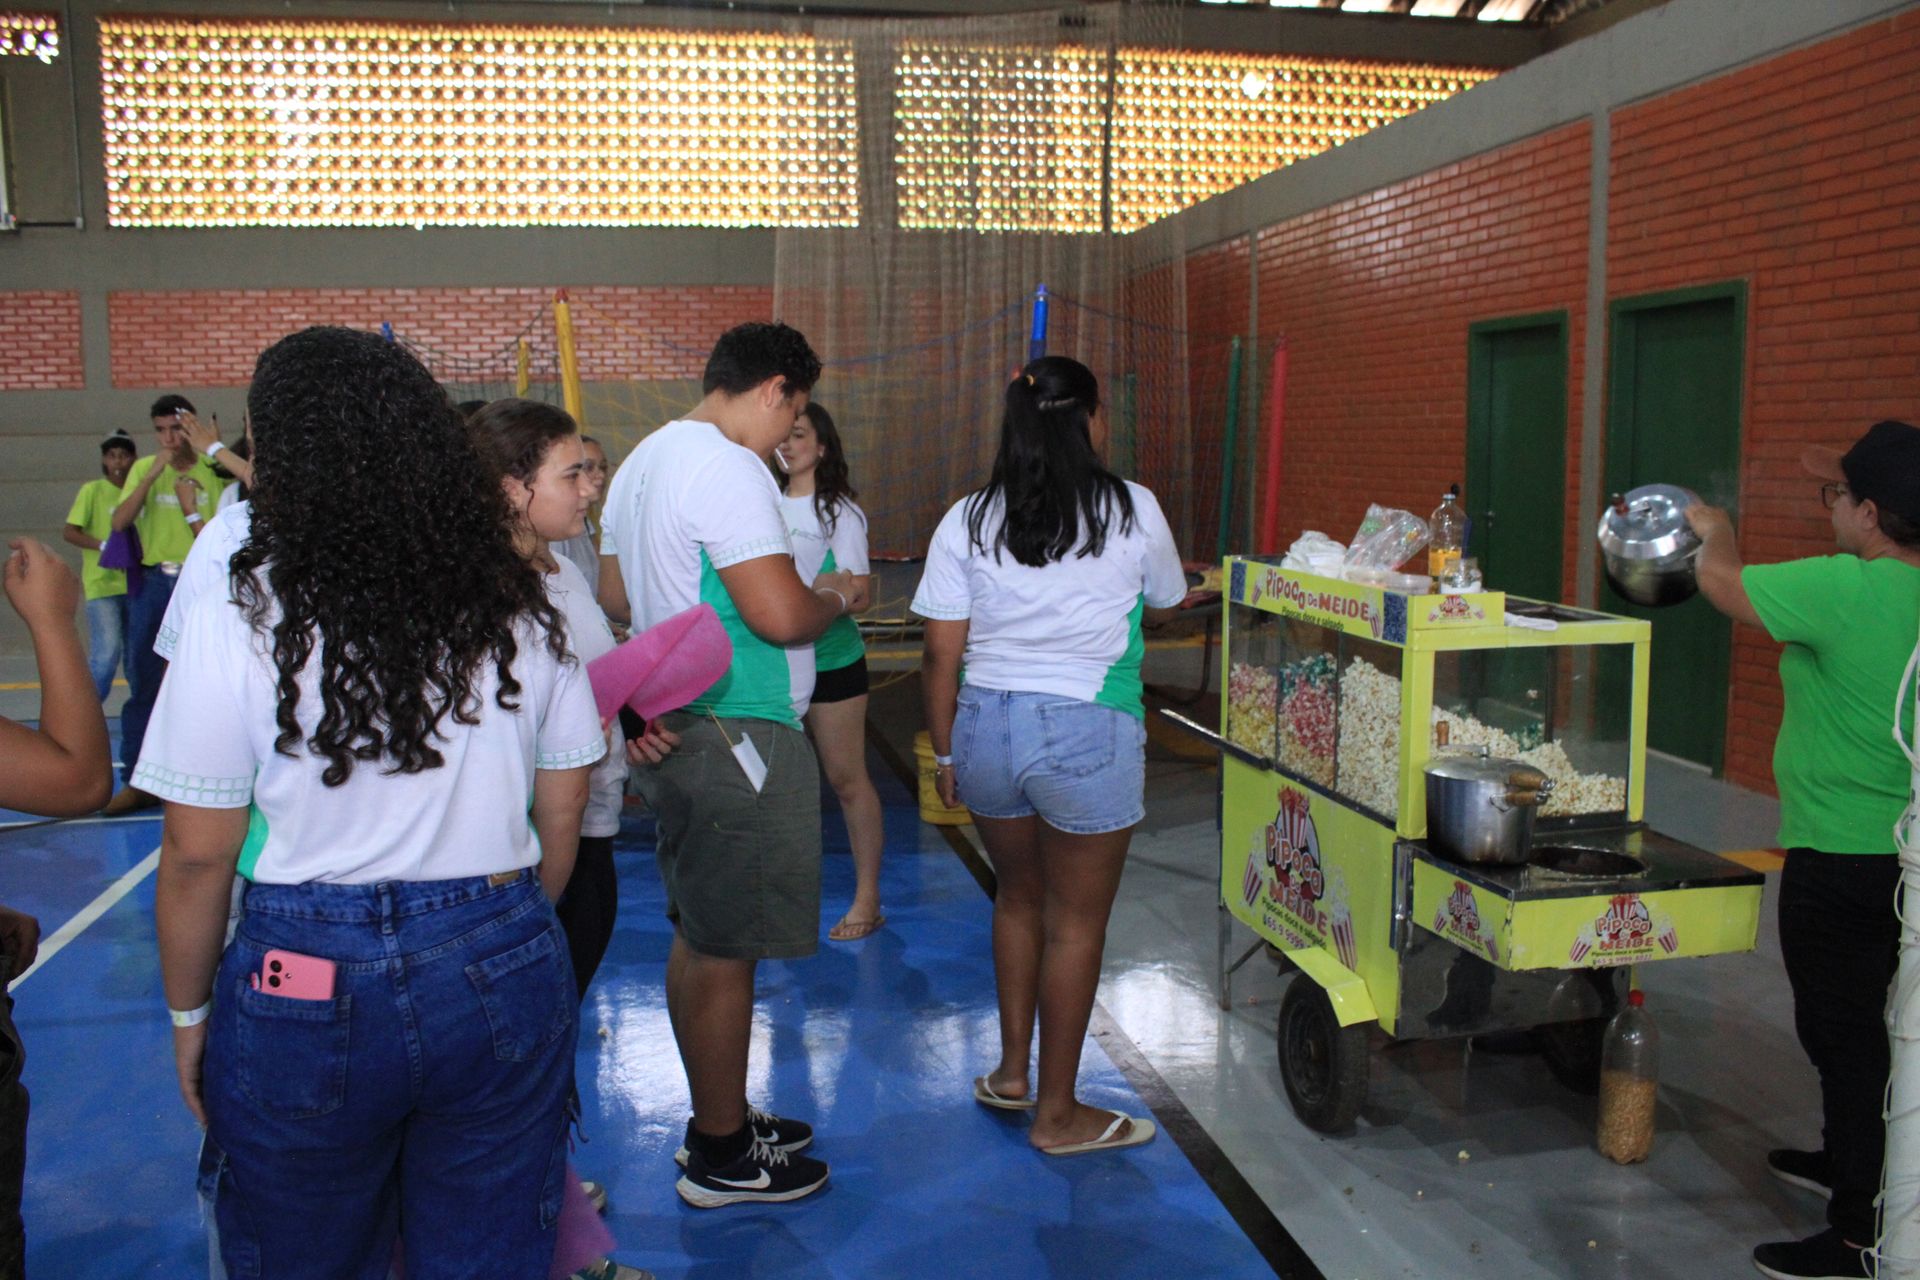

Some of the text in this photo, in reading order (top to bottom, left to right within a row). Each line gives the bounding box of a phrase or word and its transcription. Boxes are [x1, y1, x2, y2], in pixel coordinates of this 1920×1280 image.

[1318, 592, 1370, 622] NEIDE
[1269, 879, 1328, 936] NEIDE
[1599, 936, 1654, 950] NEIDE
